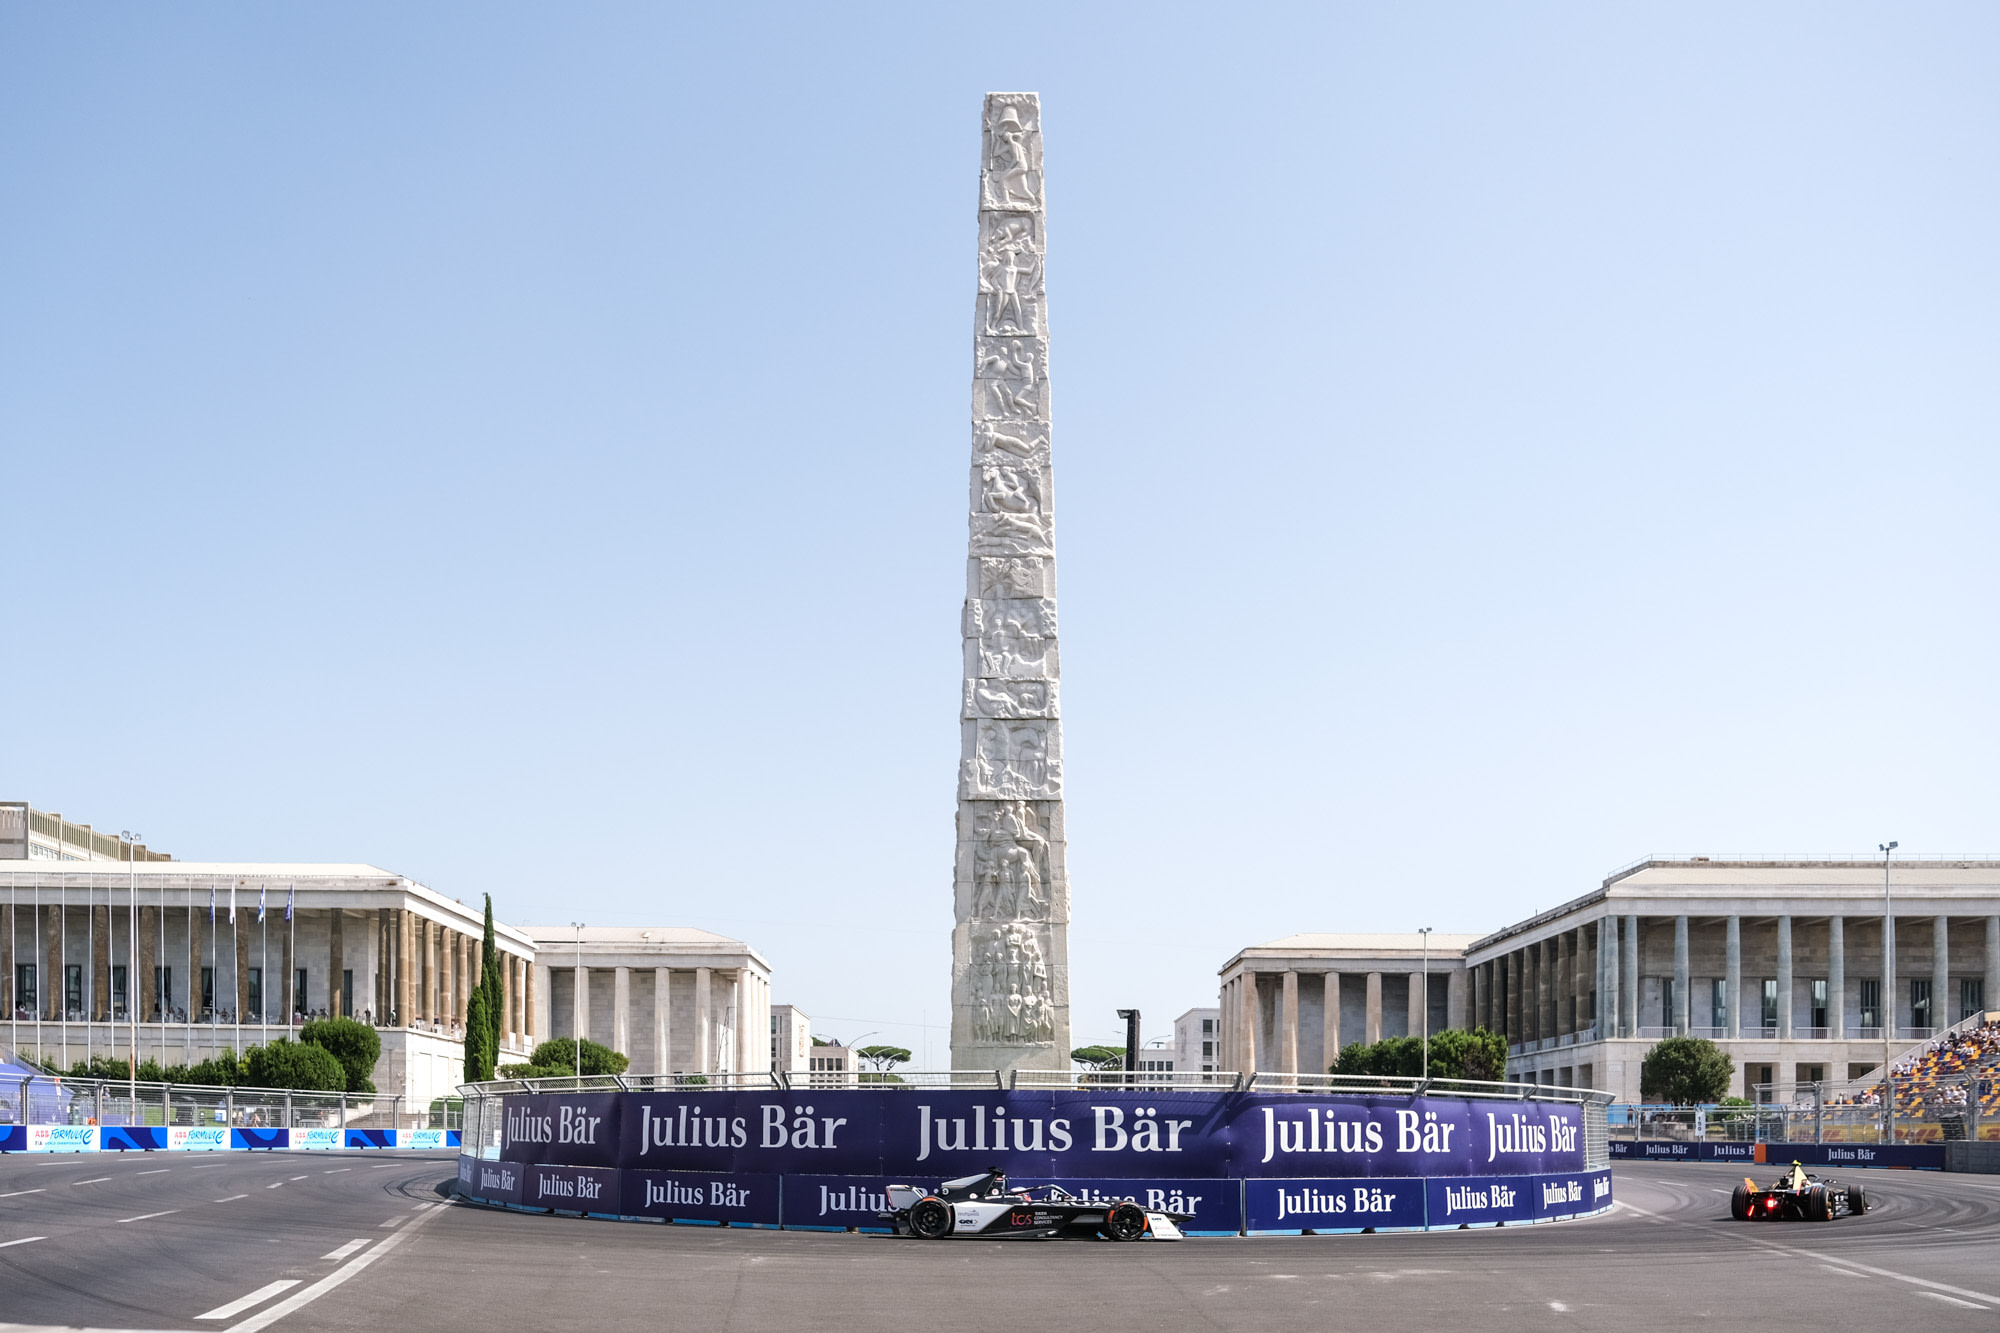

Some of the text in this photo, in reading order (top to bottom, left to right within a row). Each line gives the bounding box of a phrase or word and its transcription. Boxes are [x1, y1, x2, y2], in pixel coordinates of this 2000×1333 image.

[35, 1130, 49, 1138] ABB
[506, 1106, 600, 1149] Julius Bär
[640, 1105, 847, 1155] Julius Bär
[917, 1106, 1192, 1161] Julius Bär
[1262, 1108, 1454, 1163] Julius Bär
[1487, 1113, 1576, 1162] Julius Bär
[1615, 1144, 1627, 1153] Bär
[1646, 1145, 1688, 1155] Julius Bär
[1714, 1145, 1745, 1156] Julius
[1828, 1148, 1876, 1161] Julius Bär
[481, 1168, 500, 1190] Julius
[501, 1170, 515, 1190] Bär
[539, 1174, 601, 1198] Julius Bär
[645, 1180, 750, 1207] Julius Bär
[1145, 1189, 1202, 1215] Bär
[1278, 1188, 1395, 1219] Julius Bär
[1446, 1185, 1516, 1215] Julius Bär
[1543, 1181, 1582, 1209] Julius Bär
[1011, 1212, 1032, 1226] tcs
